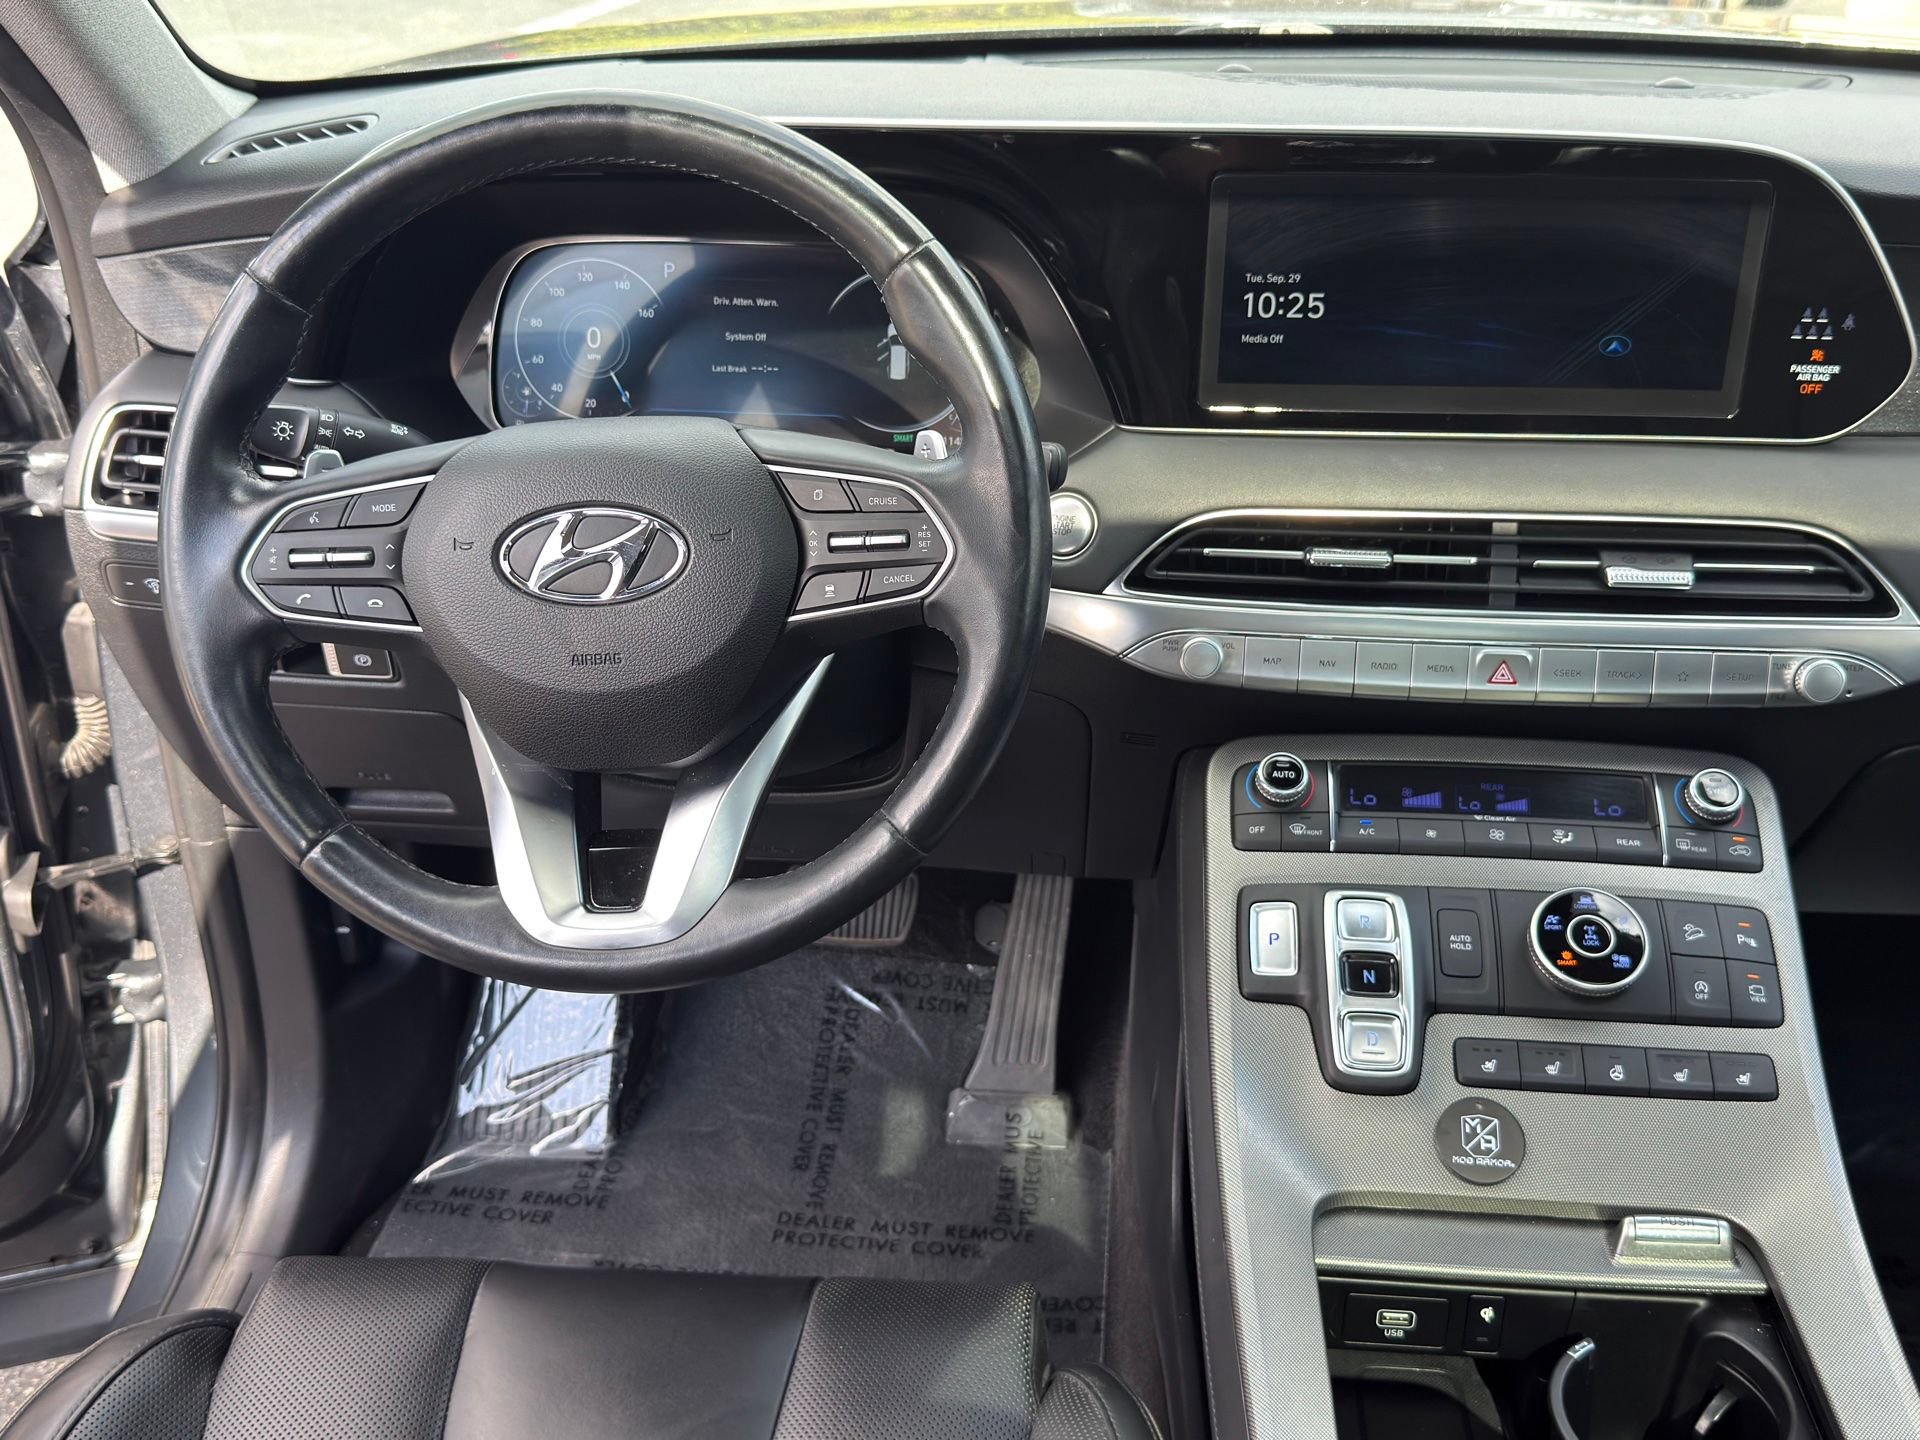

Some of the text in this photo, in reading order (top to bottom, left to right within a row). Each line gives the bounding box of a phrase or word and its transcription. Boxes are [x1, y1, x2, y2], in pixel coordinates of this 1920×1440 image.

[663, 262, 676, 279] P
[577, 272, 593, 282] 120
[1245, 273, 1301, 284] Tue. Sep. 29
[614, 281, 630, 291] 140
[550, 287, 565, 297] 100
[713, 296, 779, 308] Driv. Atten. Warn.
[1243, 291, 1326, 319] 10:25
[638, 308, 654, 318] 160
[530, 318, 543, 328] 80
[586, 326, 601, 348] 0
[725, 332, 767, 343] System Off
[1241, 334, 1284, 344] Media Off
[532, 354, 544, 365] 60
[587, 353, 601, 361] MPH
[712, 364, 727, 373] Last
[728, 365, 747, 373] Break
[1790, 364, 1841, 374] PASSENGER
[1796, 373, 1831, 382] AIR BAG
[551, 383, 563, 393] 40
[1800, 383, 1823, 394] OFF
[585, 399, 597, 408] 20
[893, 434, 914, 443] SMART
[868, 497, 898, 505] CRUISE
[372, 503, 397, 513] MODE
[883, 574, 915, 584] CANCEL
[571, 653, 622, 667] AIRBAG
[1263, 657, 1282, 665] MAP
[1319, 659, 1336, 668] NAV
[1371, 661, 1398, 671] RADIO
[1427, 664, 1454, 673] MEDIA
[1843, 664, 1864, 673] NTER
[1726, 673, 1753, 682] SETUP
[1272, 770, 1296, 779] AUTO
[1249, 826, 1265, 834] OFF
[1359, 827, 1375, 836] A/C
[1616, 838, 1641, 847] REAR
[1573, 902, 1597, 910] COMFOR
[1359, 915, 1372, 928] R
[1544, 923, 1562, 931] SPORT
[1269, 933, 1280, 946] P
[1450, 935, 1472, 943] AUTO
[1582, 938, 1600, 946] LOCK
[1450, 942, 1472, 950] HOLD
[1556, 959, 1577, 967] SMART
[1363, 969, 1376, 984] N
[1367, 1031, 1380, 1046] D
[826, 1088, 848, 1134] MUST
[1002, 1111, 1022, 1153] MUS
[792, 1117, 818, 1173] COVER
[1452, 1155, 1473, 1164] MOD
[805, 1143, 838, 1212] REMOVE
[450, 1186, 510, 1203] MUST
[520, 1189, 610, 1210] REMOVE
[482, 1205, 555, 1225] COVER
[776, 1211, 1035, 1243] DEALER MUST REMOVE
[771, 1228, 986, 1259] PROTECTIVE COVER
[1384, 1328, 1404, 1338] USB
